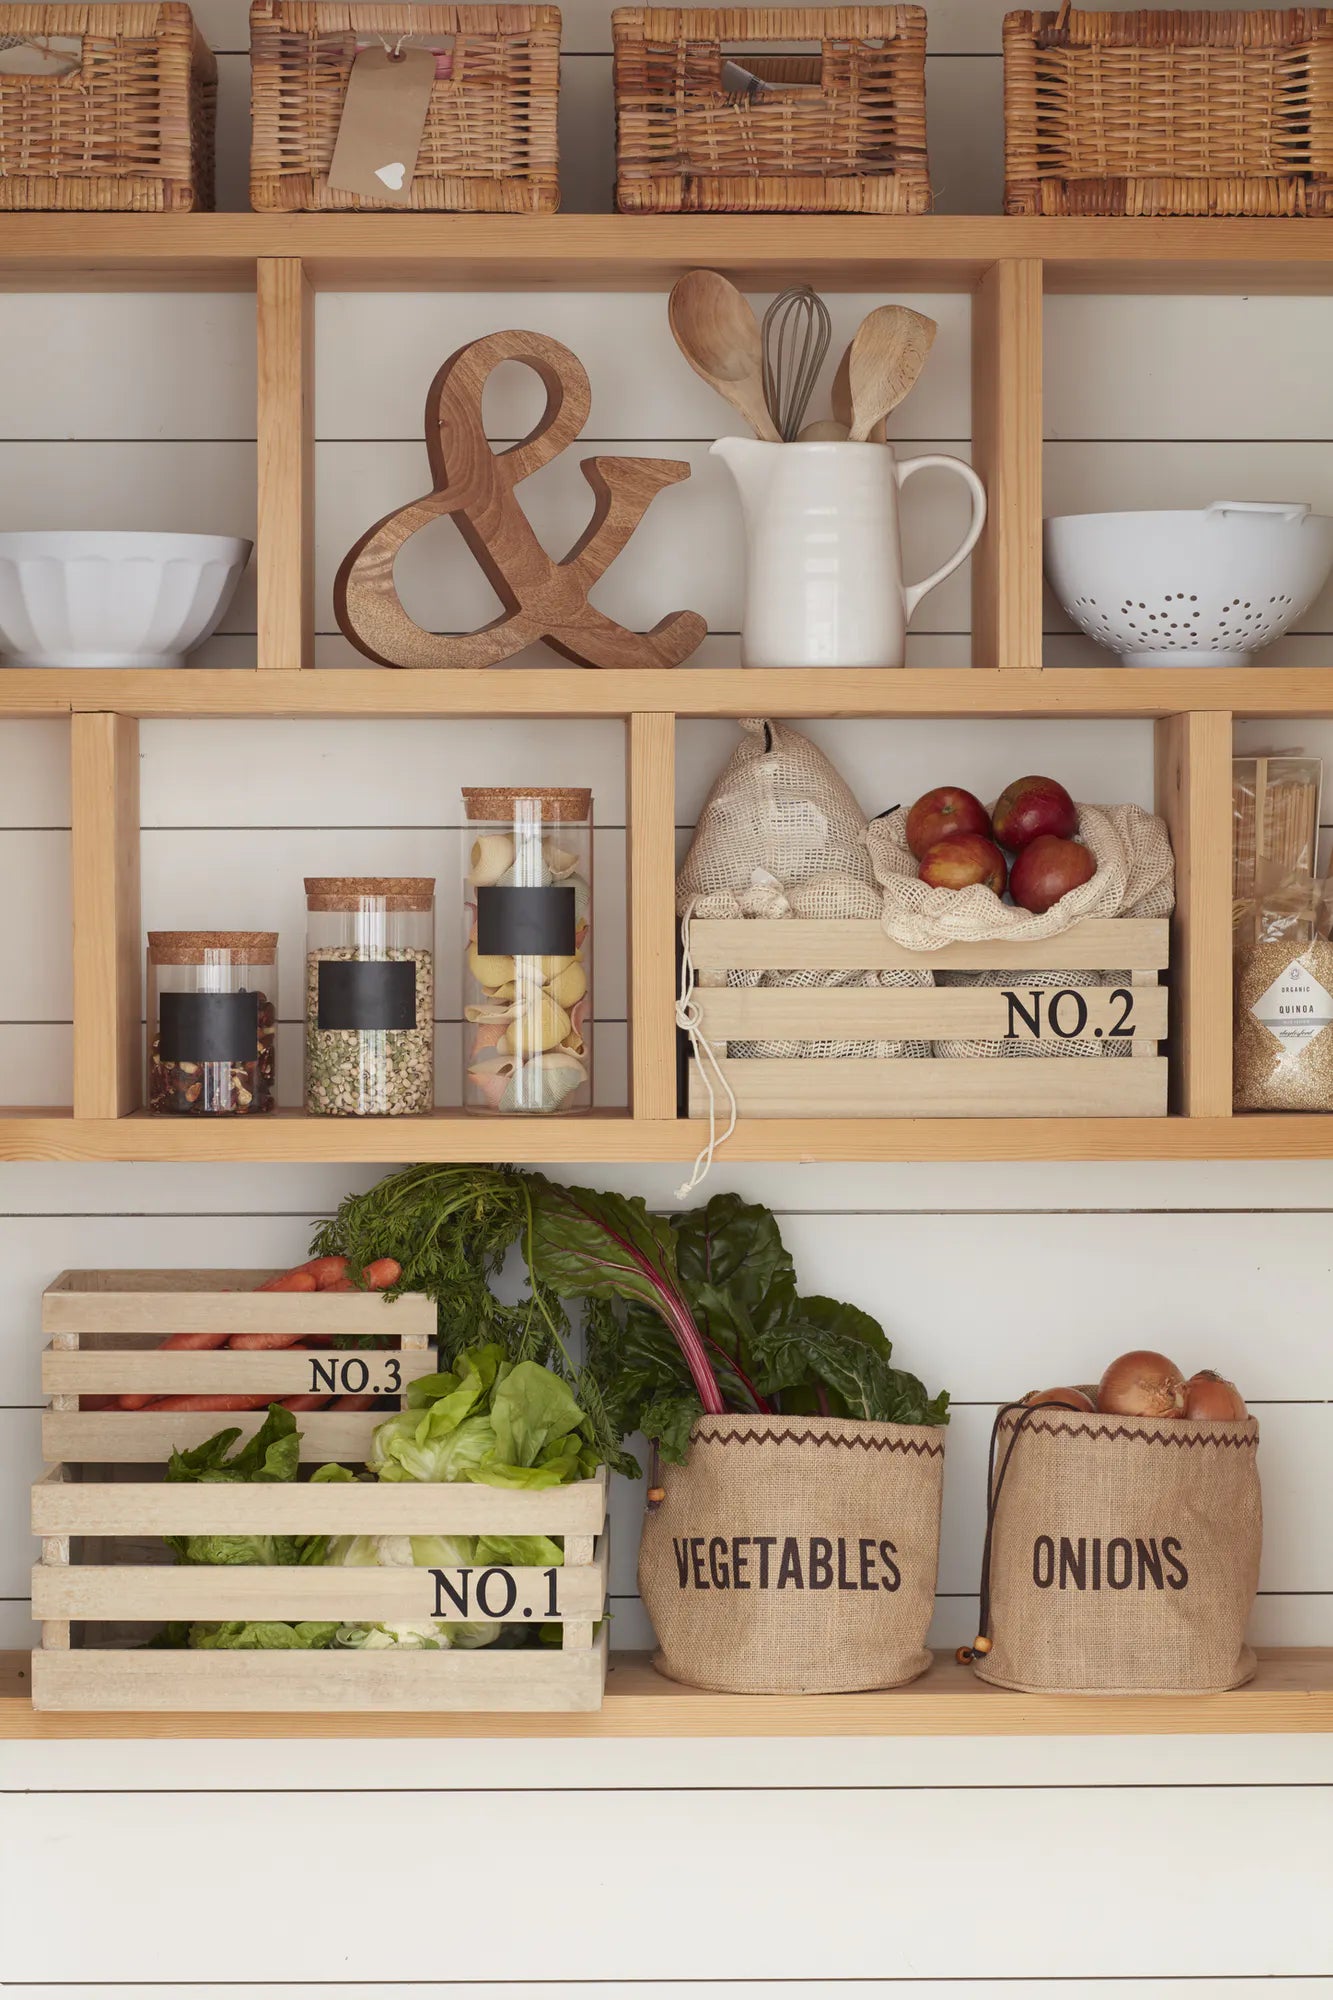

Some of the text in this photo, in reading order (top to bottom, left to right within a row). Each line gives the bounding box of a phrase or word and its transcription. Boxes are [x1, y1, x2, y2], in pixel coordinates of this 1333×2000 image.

[333, 329, 707, 669] &
[1001, 989, 1136, 1039] NO.2
[1279, 1004, 1314, 1014] QUINOA
[308, 1358, 403, 1394] NO.3
[673, 1536, 901, 1592] VEGETABLES
[1033, 1535, 1189, 1591] ONIONS
[428, 1567, 563, 1618] NO.1
